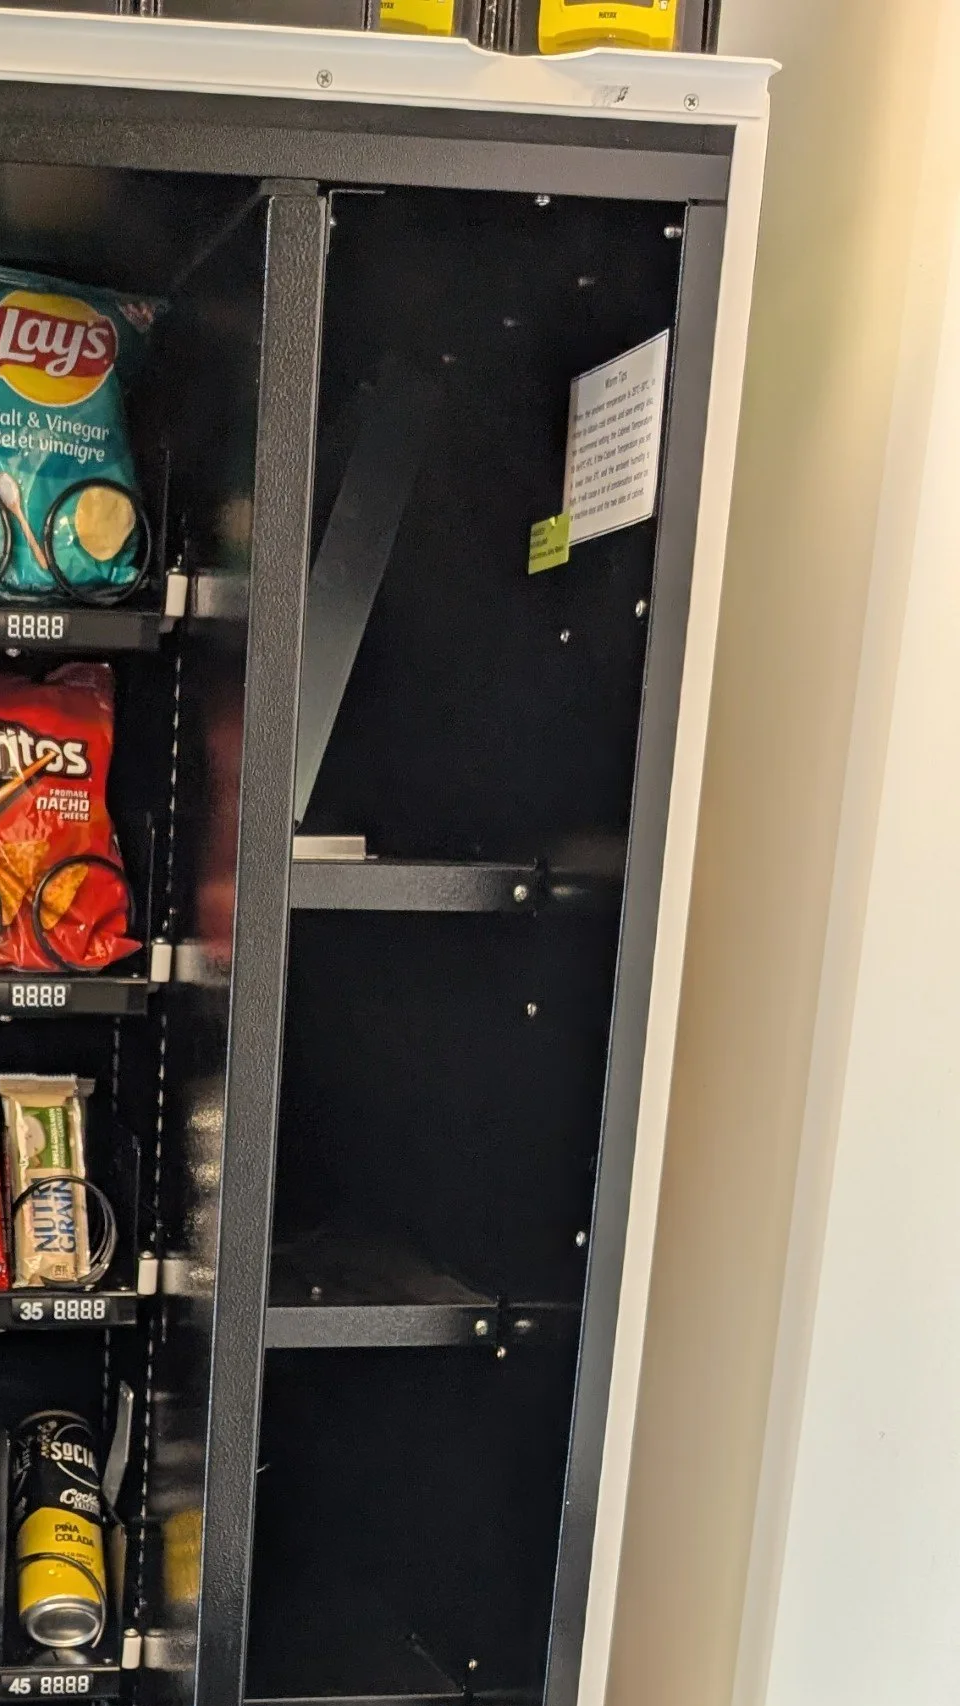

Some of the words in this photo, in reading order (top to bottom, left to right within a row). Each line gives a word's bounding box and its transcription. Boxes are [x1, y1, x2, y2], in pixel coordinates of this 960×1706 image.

[27, 411, 40, 429] &
[45, 414, 110, 442] Vinegar
[18, 433, 33, 449] et
[39, 437, 105, 465] vinaigre
[36, 795, 90, 813] NACHO
[20, 1302, 43, 1319] 35
[9, 1677, 31, 1694] 45
